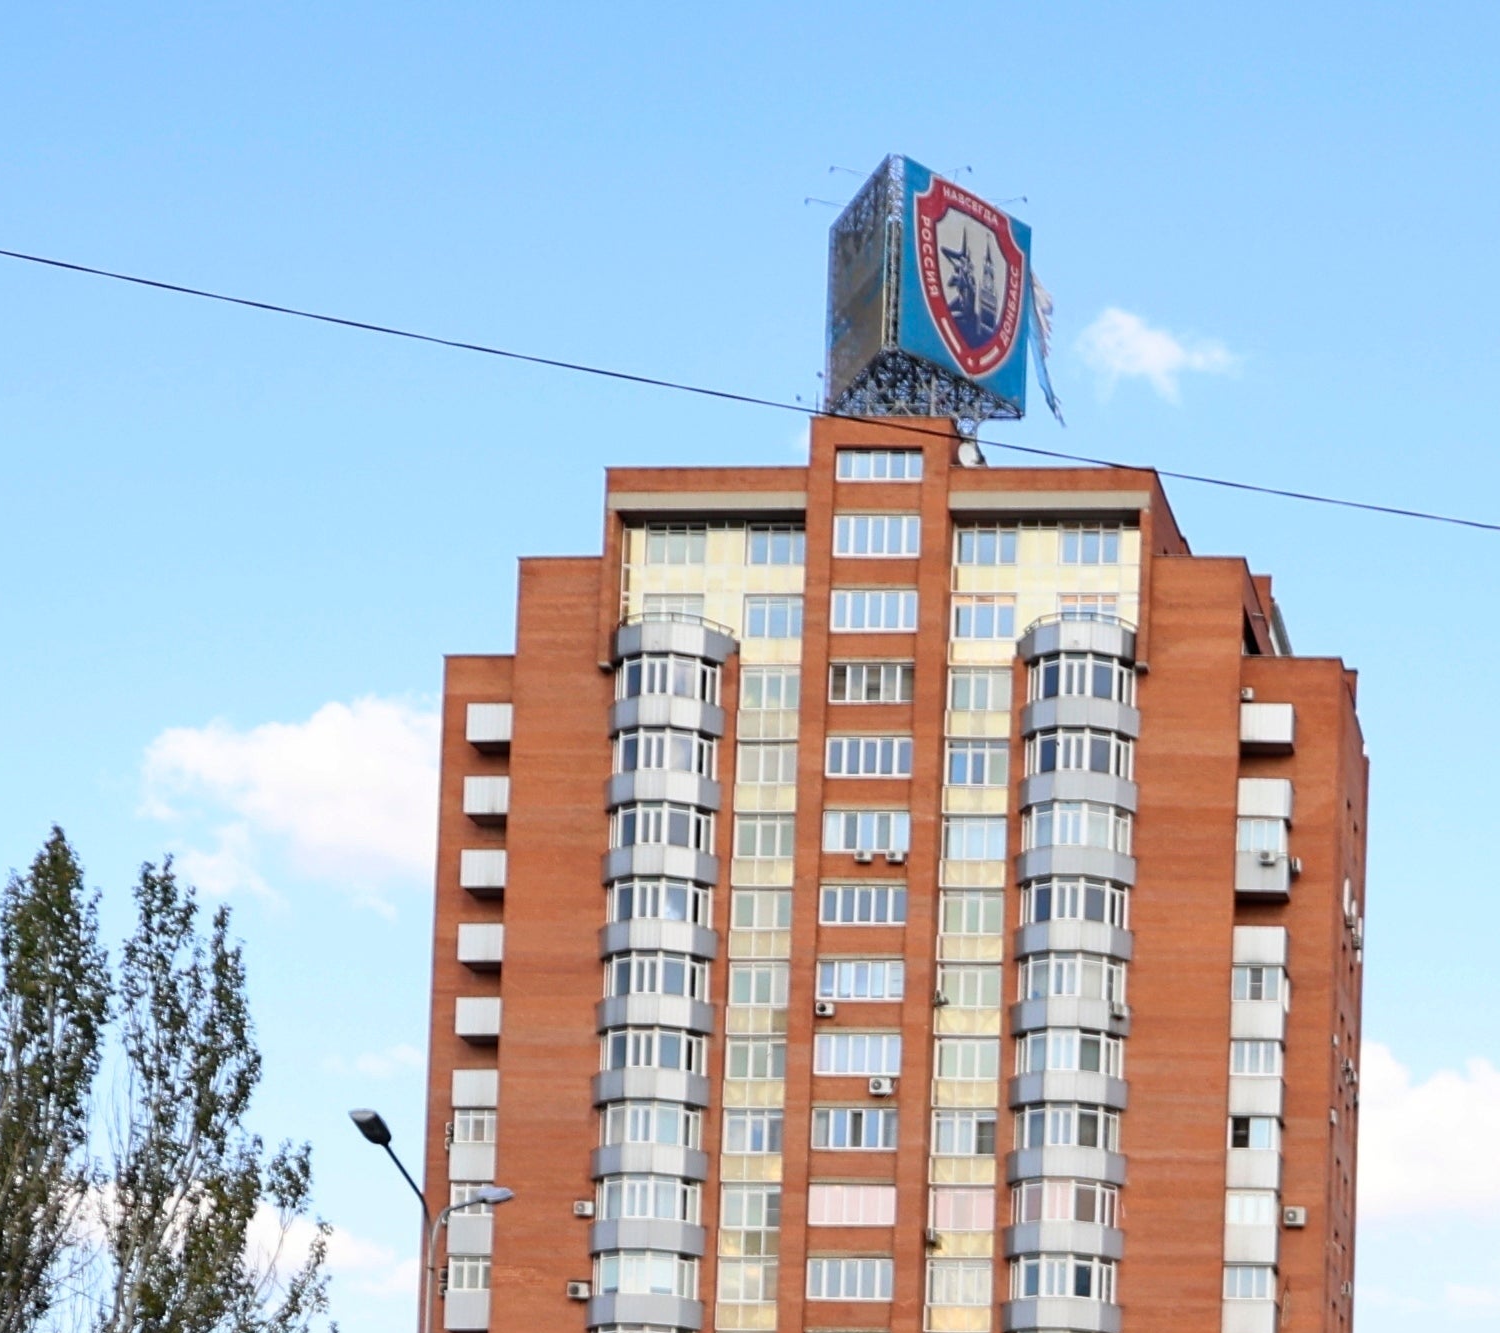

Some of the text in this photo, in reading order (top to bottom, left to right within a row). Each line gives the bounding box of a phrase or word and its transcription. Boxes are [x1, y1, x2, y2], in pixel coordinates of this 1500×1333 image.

[943, 186, 999, 226] НАВСЕГДА
[921, 215, 940, 296] РОССИЯ
[1000, 264, 1019, 346] ДОНБАСС
